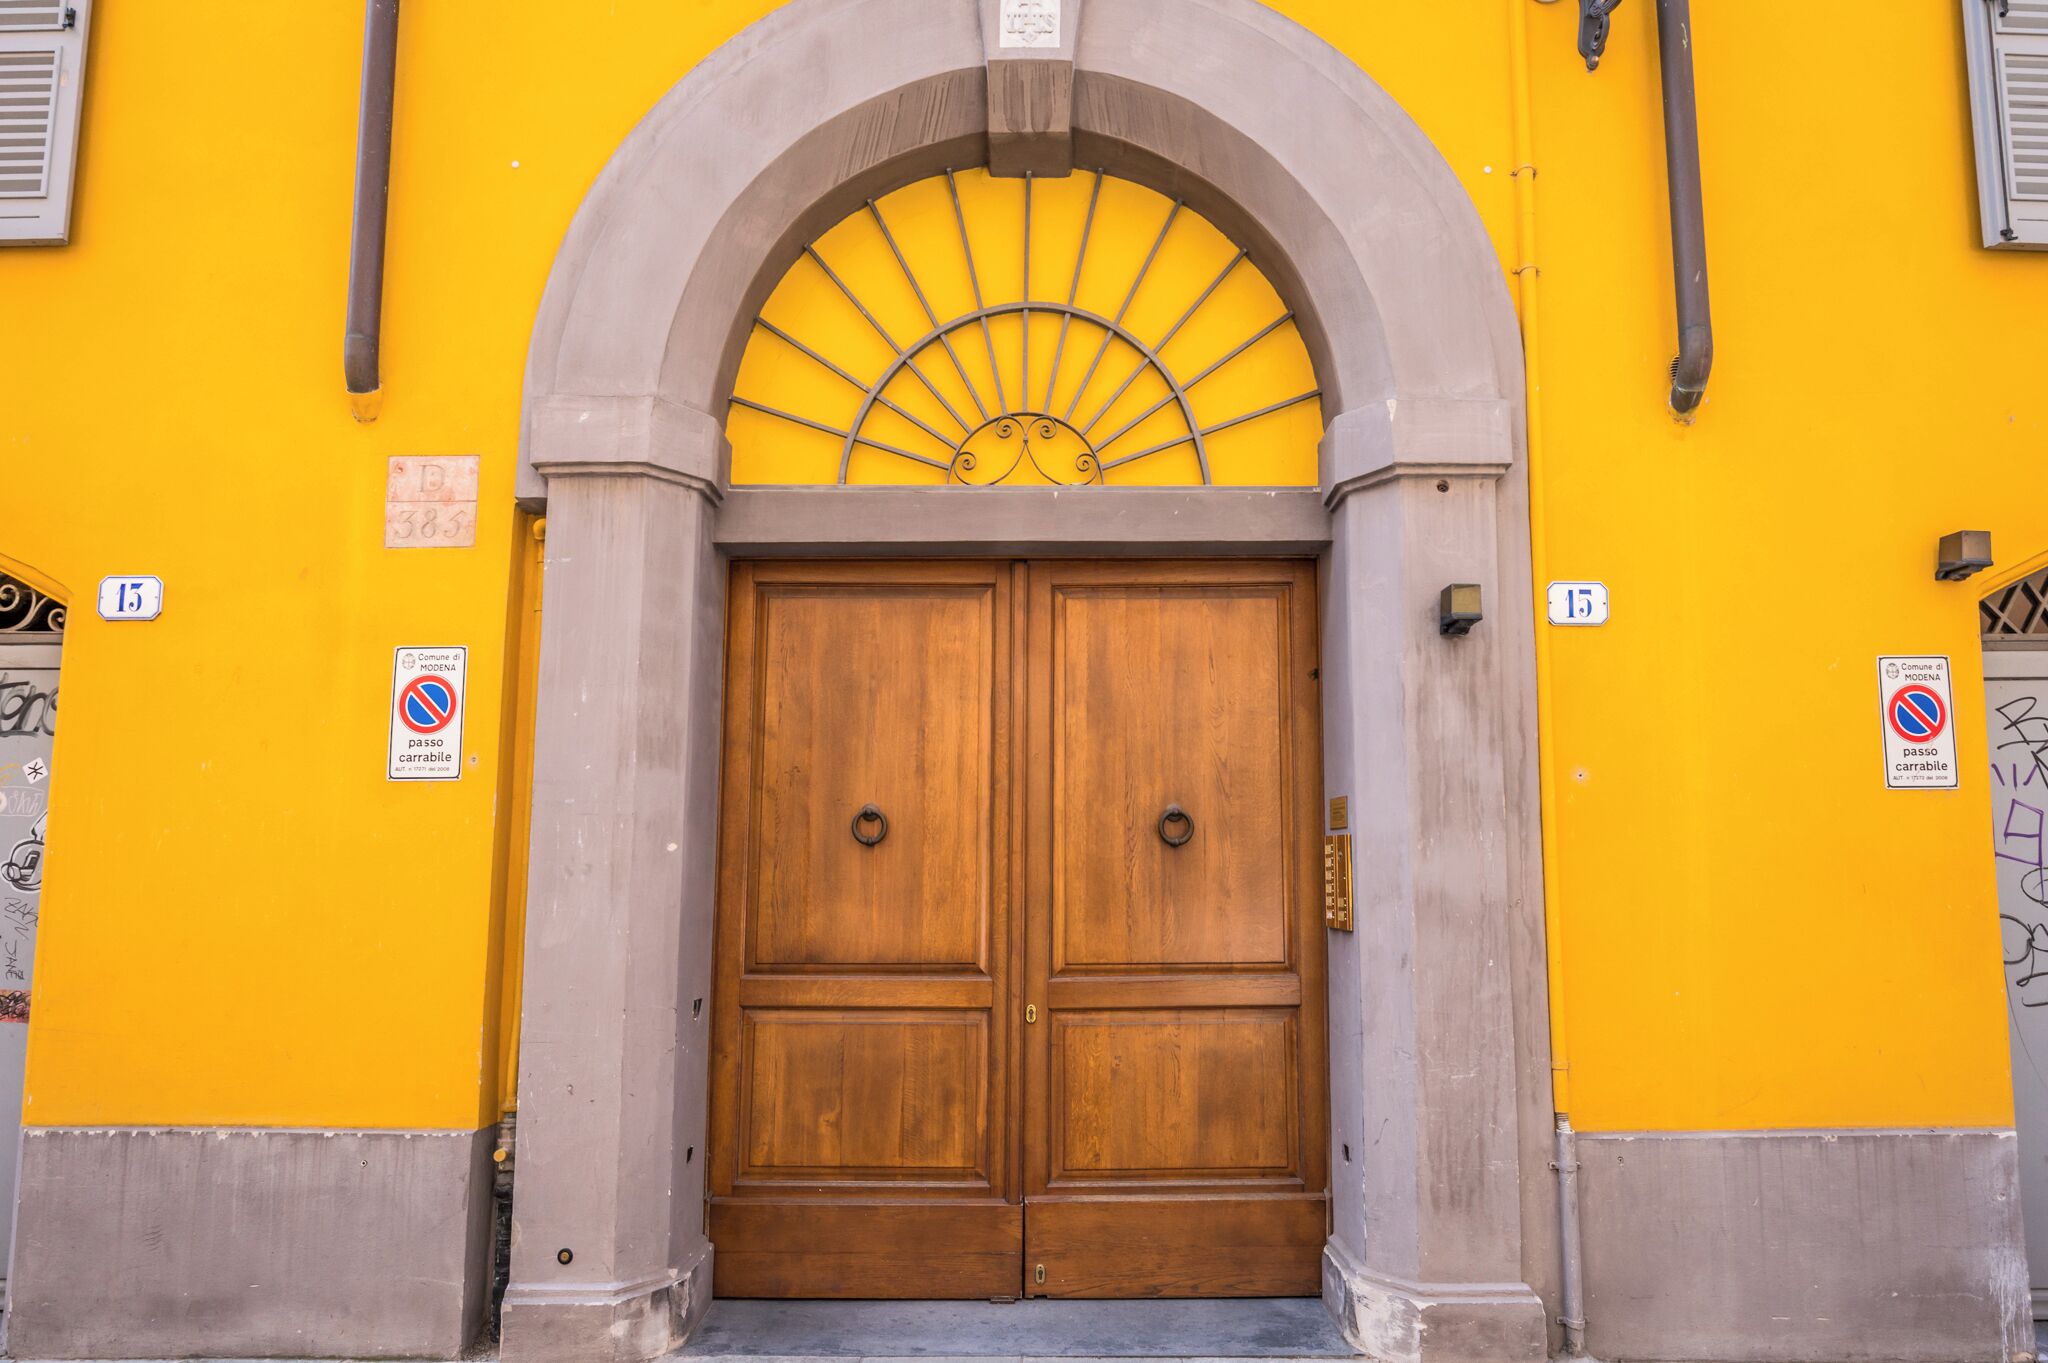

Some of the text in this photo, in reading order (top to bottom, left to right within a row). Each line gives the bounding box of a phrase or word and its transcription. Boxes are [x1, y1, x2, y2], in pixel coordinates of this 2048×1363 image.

[419, 464, 445, 493] D
[1564, 588, 1593, 619] 15
[418, 653, 461, 661] Comune di
[420, 664, 457, 672] MODENA
[1901, 662, 1943, 671] Comune di
[1904, 673, 1941, 681] MODENA
[408, 738, 444, 749] passo
[399, 752, 452, 763] carrabile
[1903, 747, 1938, 758] passo
[1895, 760, 1948, 772] carrabile
